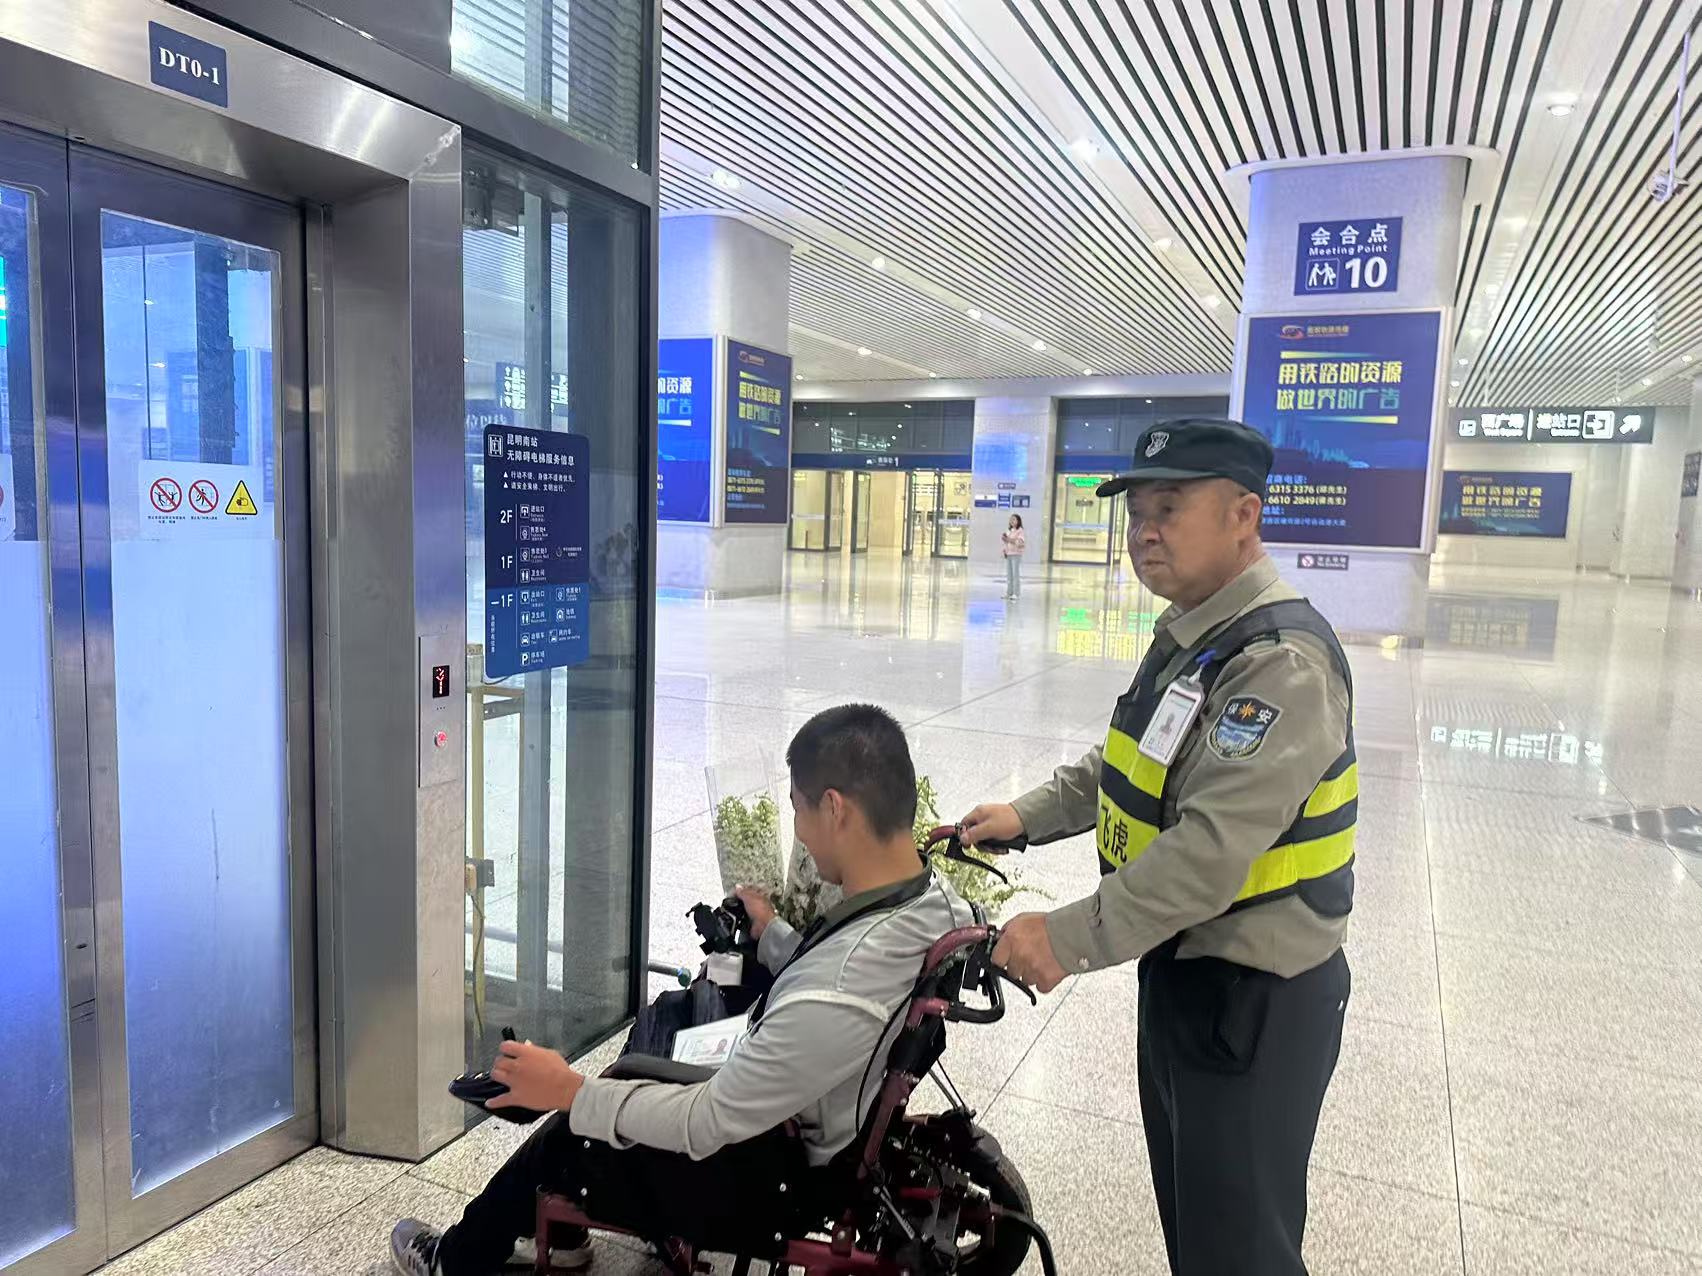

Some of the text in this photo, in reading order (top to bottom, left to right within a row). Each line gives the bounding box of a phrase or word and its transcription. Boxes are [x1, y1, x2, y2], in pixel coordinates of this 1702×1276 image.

[159, 46, 220, 85] DT0-1
[1310, 223, 1388, 246] 会合点
[1308, 243, 1388, 256] Meeting Point
[1344, 256, 1388, 288] 10
[1278, 361, 1402, 384] 用铁路的资源
[1276, 388, 1400, 410] 做世界的广告
[507, 433, 538, 447] 昆明南站
[507, 449, 575, 466] 无障碍电梯服务信息
[500, 510, 513, 524] 2F
[501, 555, 513, 569] 1F
